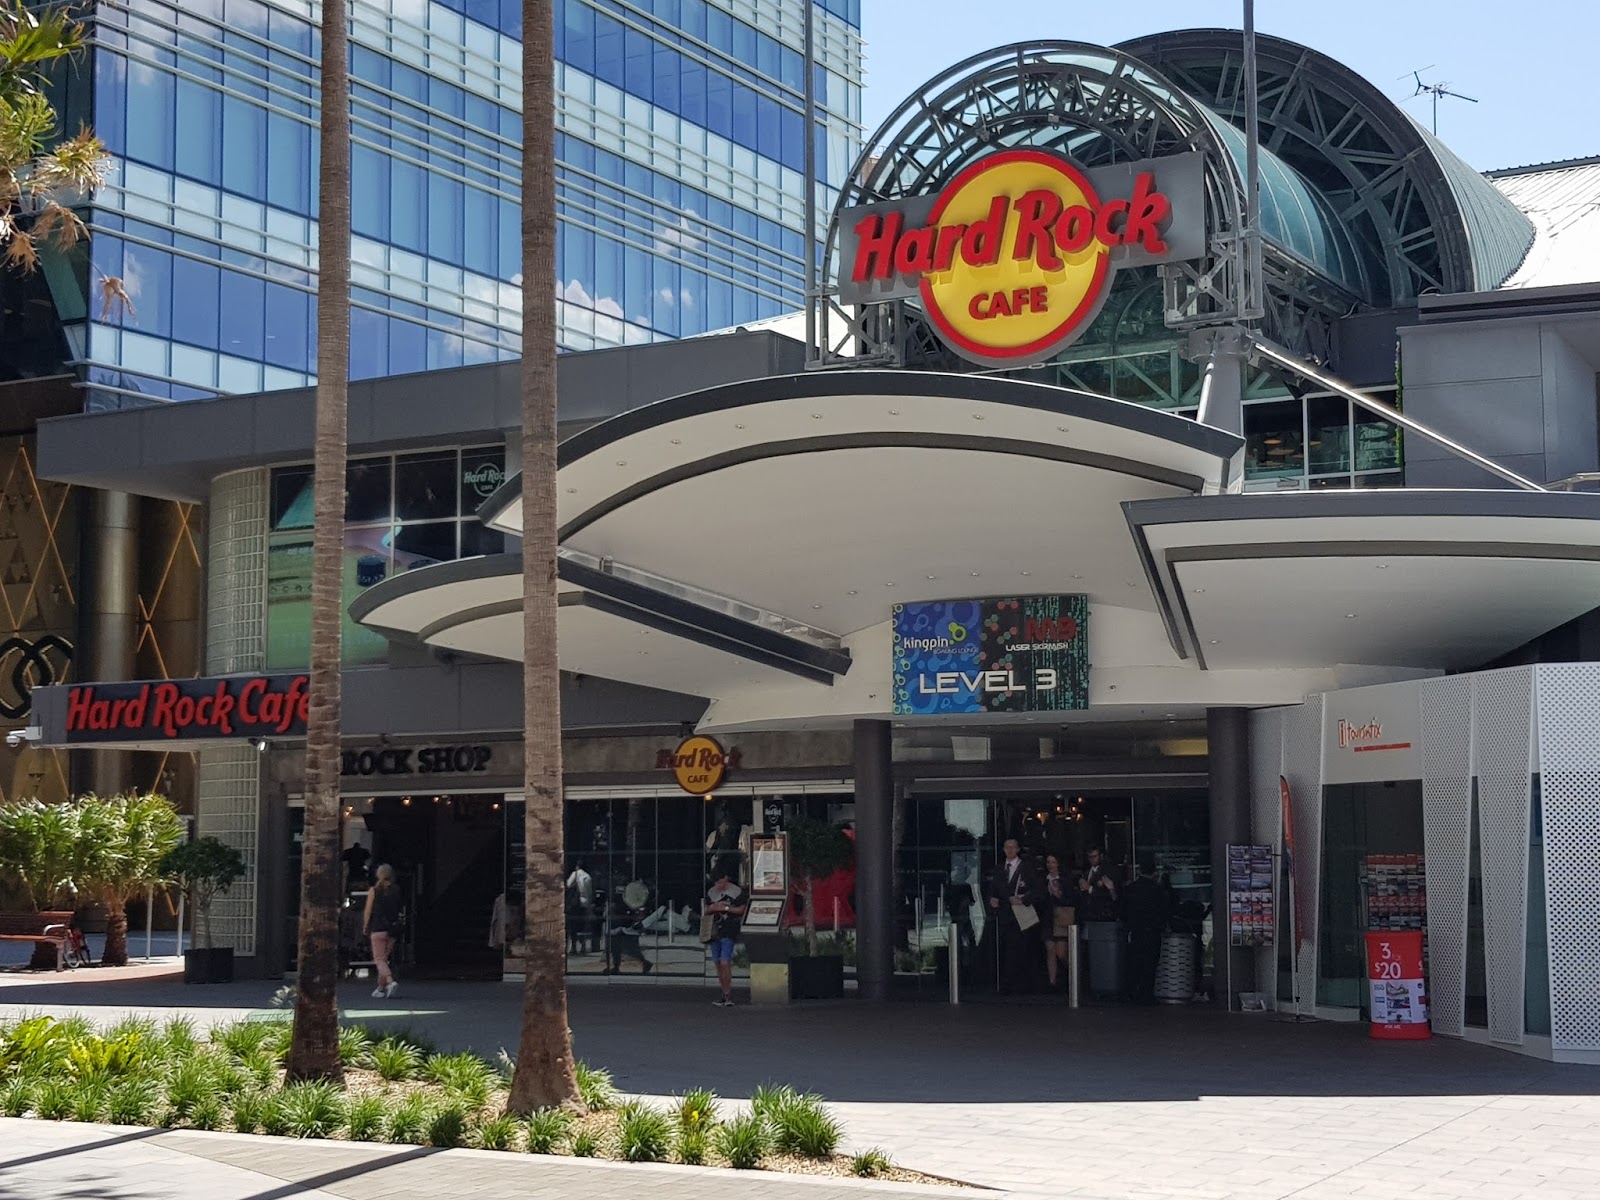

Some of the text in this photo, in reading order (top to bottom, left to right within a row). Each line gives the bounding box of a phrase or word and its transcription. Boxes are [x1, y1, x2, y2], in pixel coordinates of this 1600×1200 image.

[852, 171, 1172, 283] Hard Rock
[968, 285, 1048, 320] CAFE
[464, 469, 505, 483] Hard Roc
[903, 636, 949, 652] kingpin
[1005, 643, 1031, 652] LASER
[919, 668, 1057, 694] LEVEL 3
[66, 684, 151, 731] Hard
[152, 680, 236, 738] Rock
[340, 746, 491, 775] ROCK SHOP
[656, 748, 698, 769] Hard
[687, 774, 709, 784] CAFE
[1379, 942, 1392, 960] 3
[1374, 961, 1402, 979] $20
